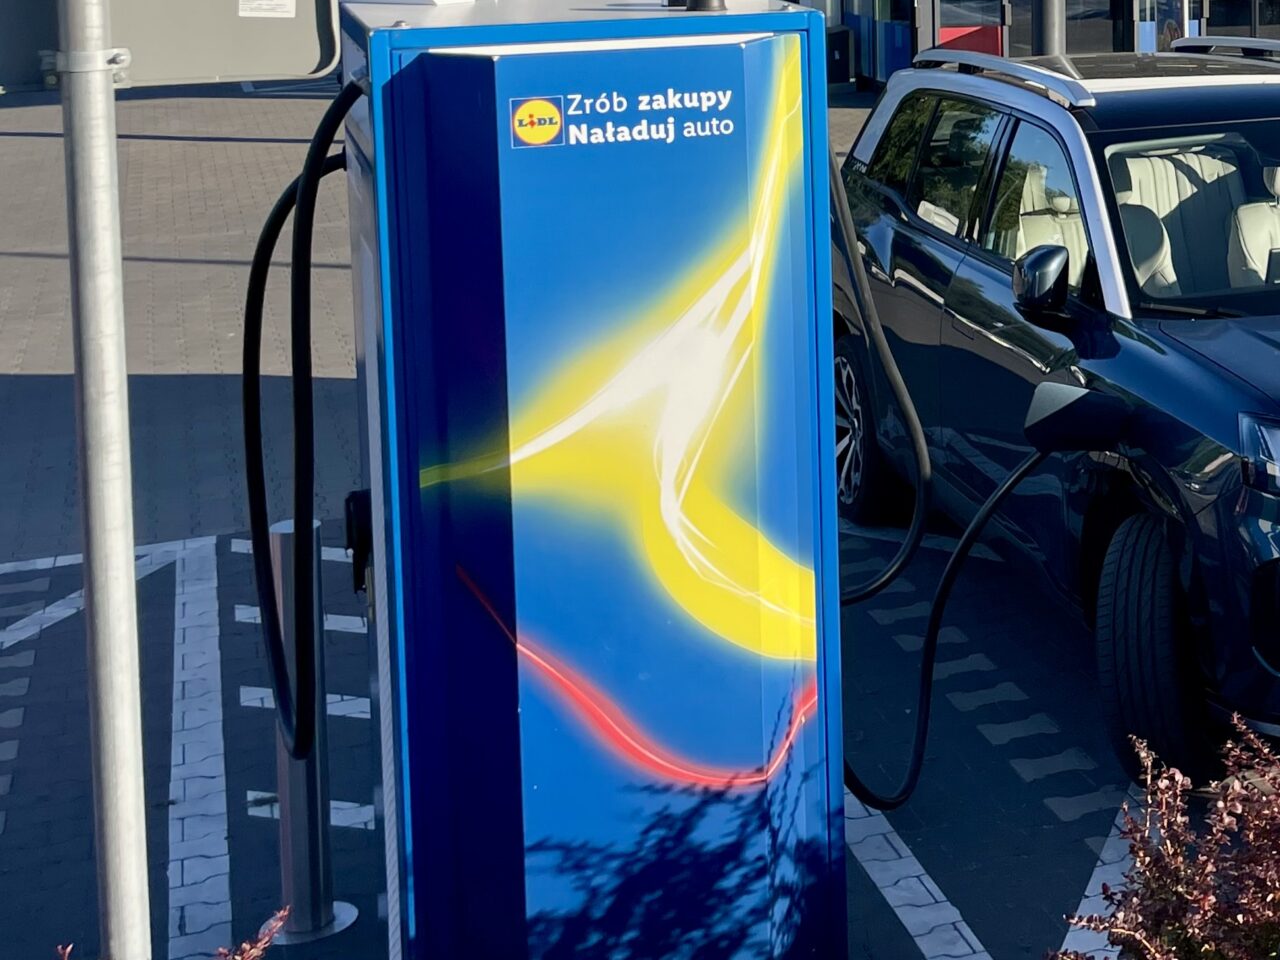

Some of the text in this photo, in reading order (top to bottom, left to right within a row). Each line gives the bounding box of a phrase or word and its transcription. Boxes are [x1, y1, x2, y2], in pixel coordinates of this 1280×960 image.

[567, 88, 732, 115] Zrób zakupy
[569, 117, 734, 144] Naładuj auto
